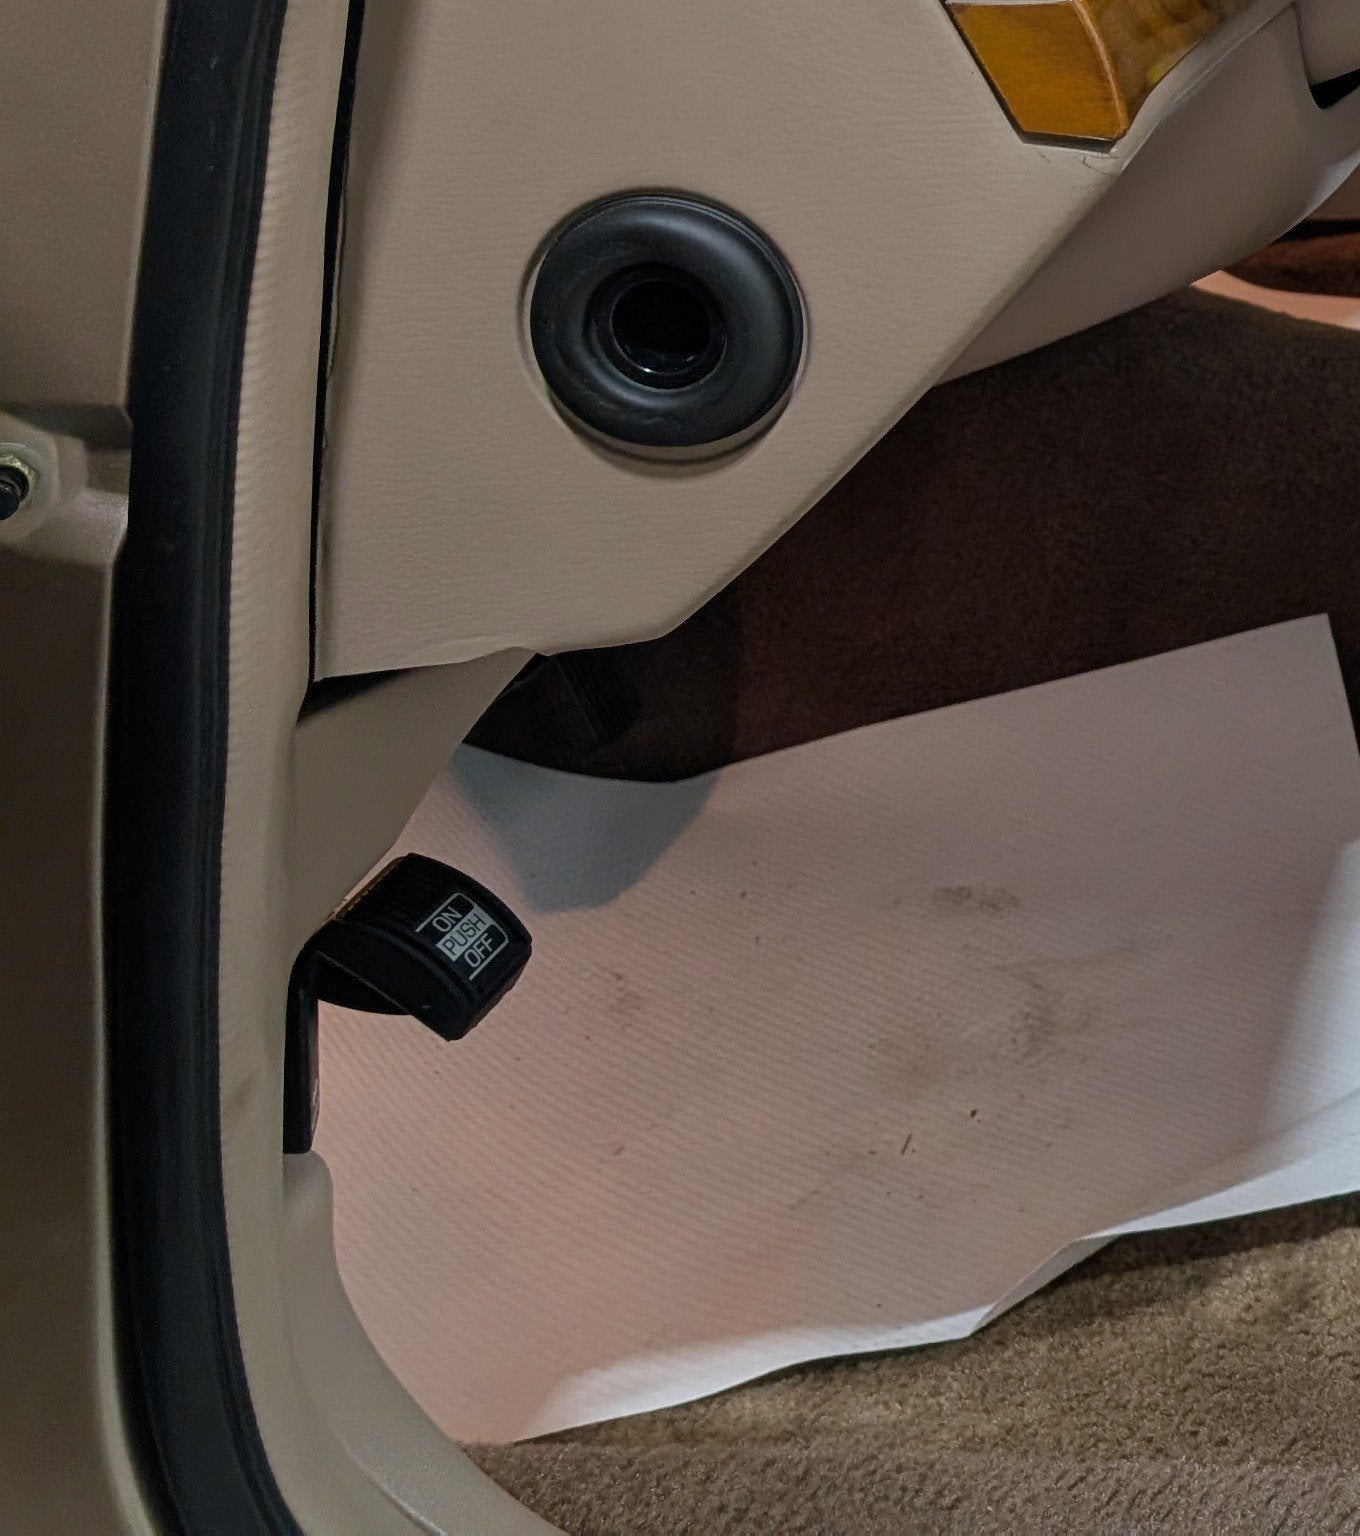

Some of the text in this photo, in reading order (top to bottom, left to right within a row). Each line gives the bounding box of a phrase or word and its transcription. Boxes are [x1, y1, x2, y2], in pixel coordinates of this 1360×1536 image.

[433, 906, 462, 933] ON
[442, 913, 486, 955] PUSH
[464, 933, 492, 967] OFF
